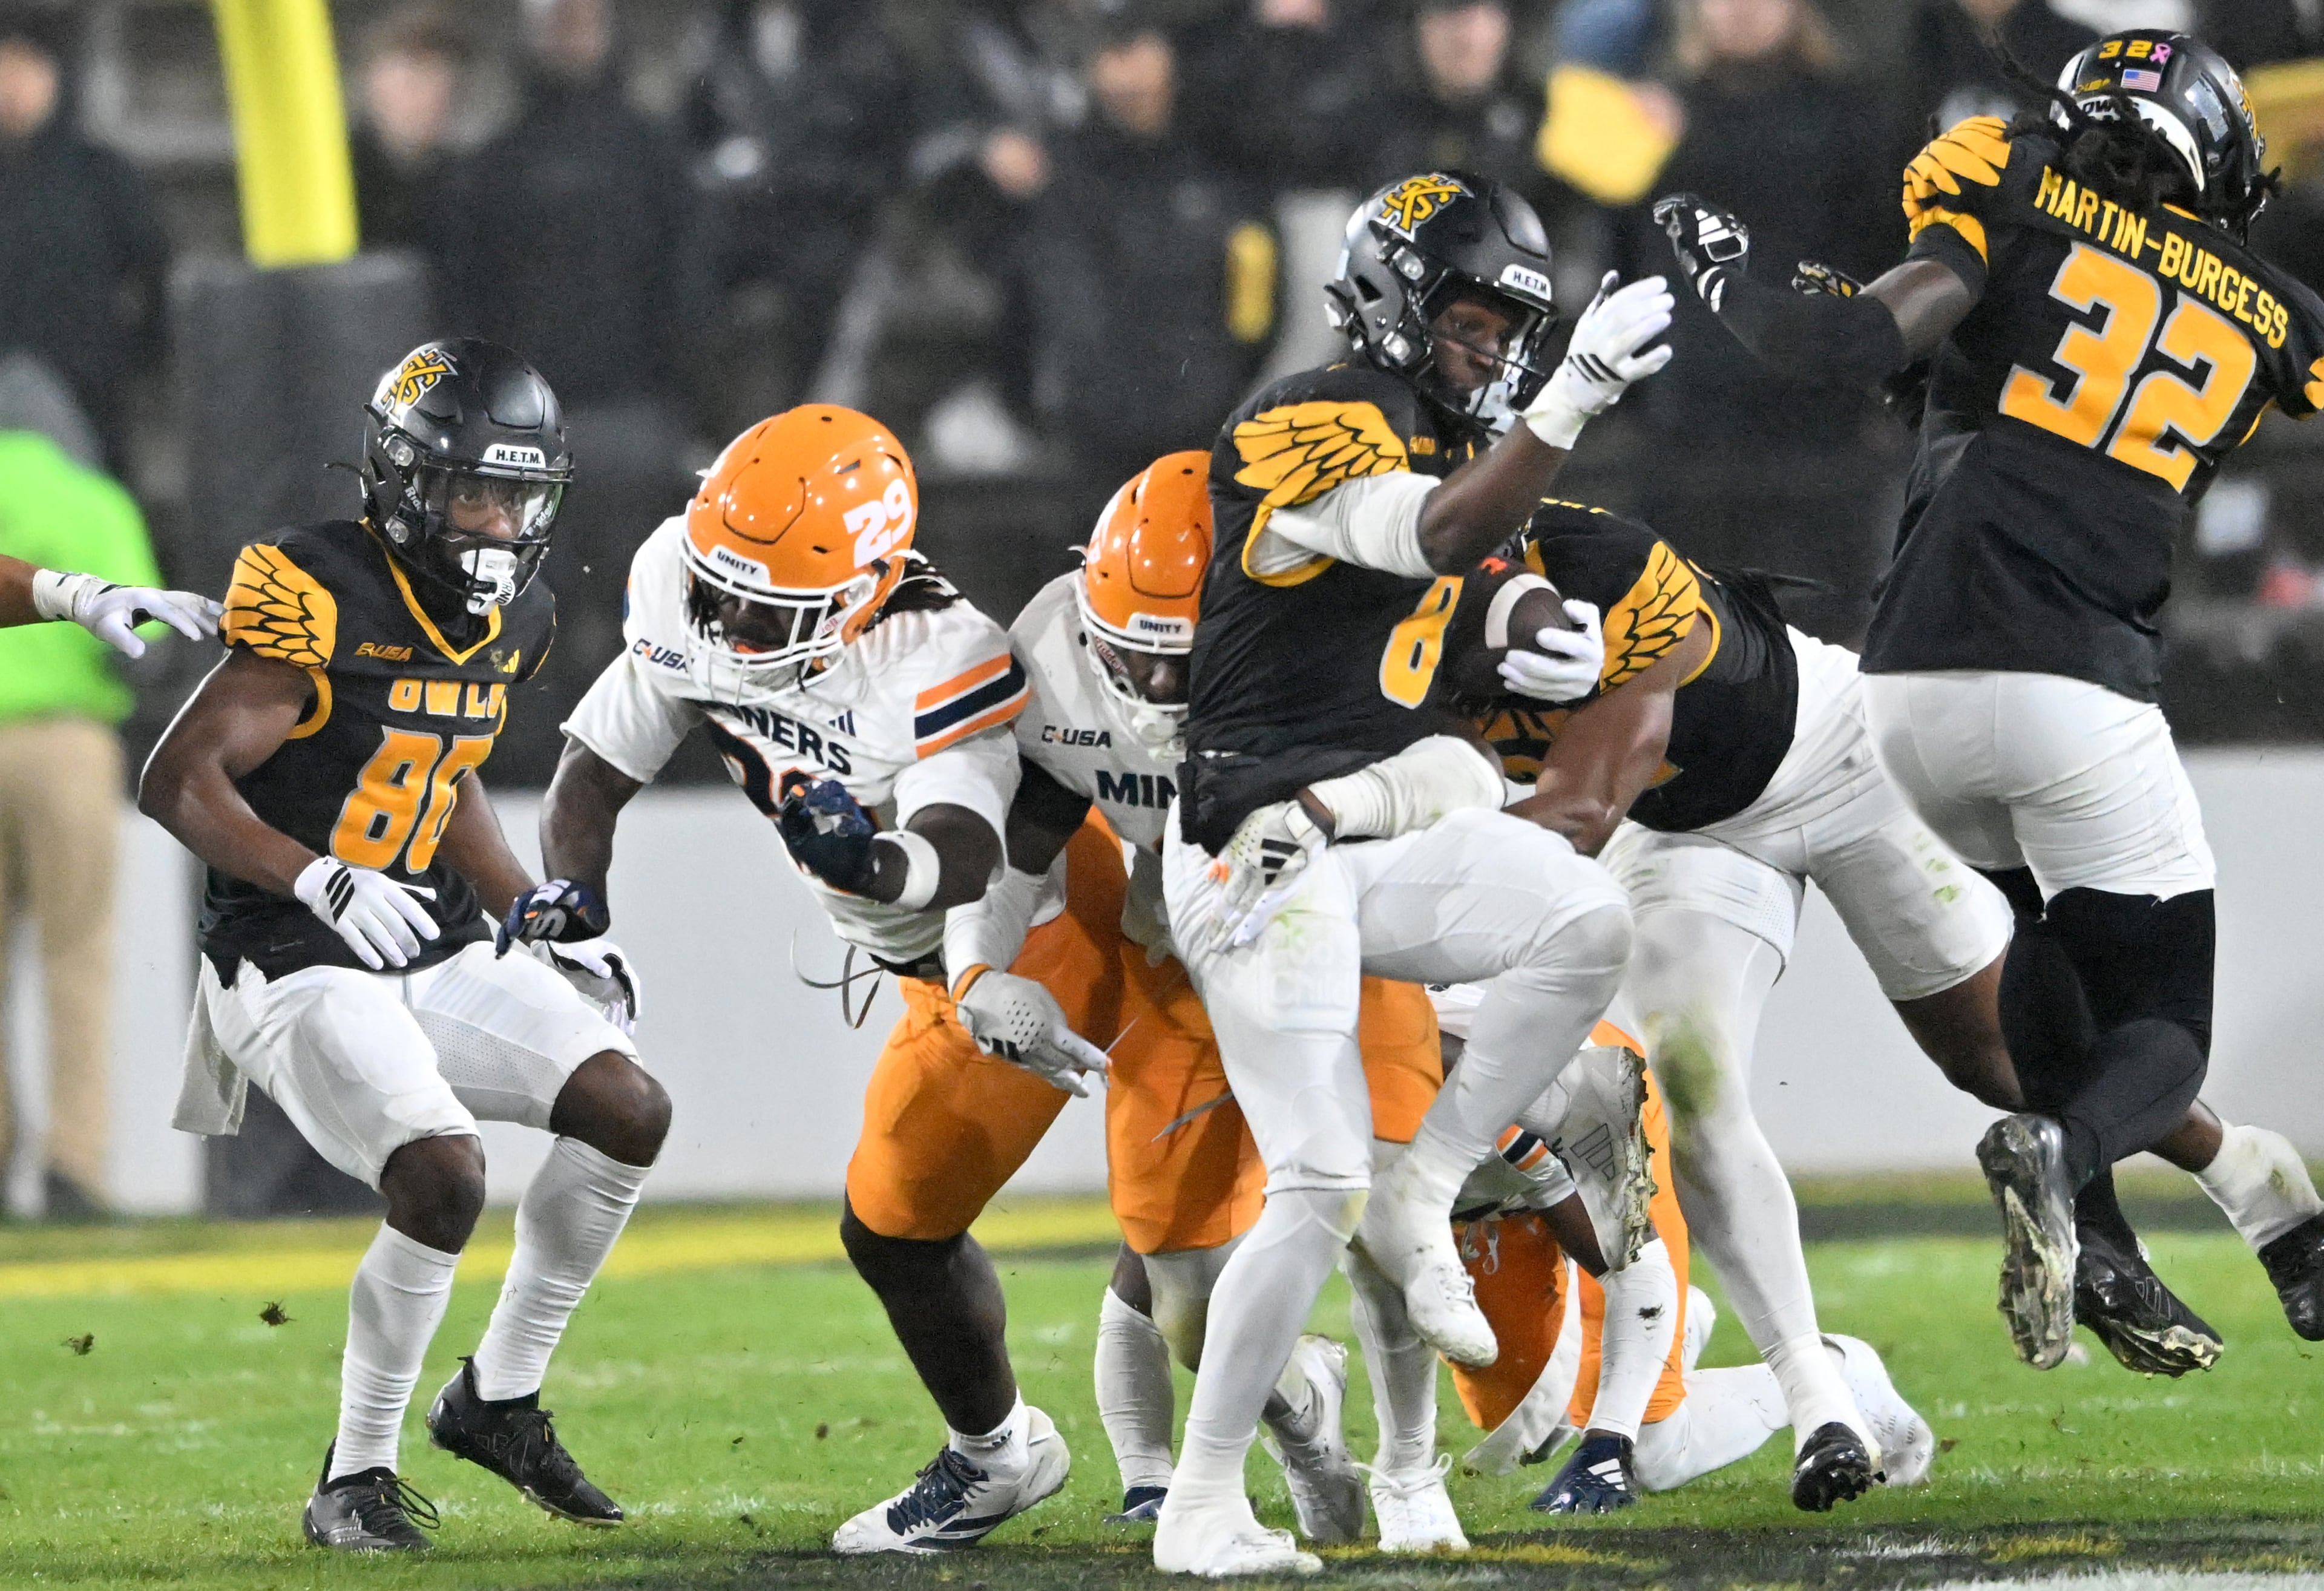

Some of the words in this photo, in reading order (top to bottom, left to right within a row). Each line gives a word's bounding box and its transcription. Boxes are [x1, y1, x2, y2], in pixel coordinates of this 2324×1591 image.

[2099, 40, 2153, 59] 32
[2034, 165, 2289, 349] MARTIN-BURGESS
[1998, 241, 2256, 493] 32
[496, 449, 541, 464] H.E.T.M.
[842, 478, 913, 569] 29
[717, 551, 758, 575] UNITY
[1139, 619, 1183, 634] UNITY
[1379, 575, 1465, 710] 8
[1094, 769, 1177, 810] MIN
